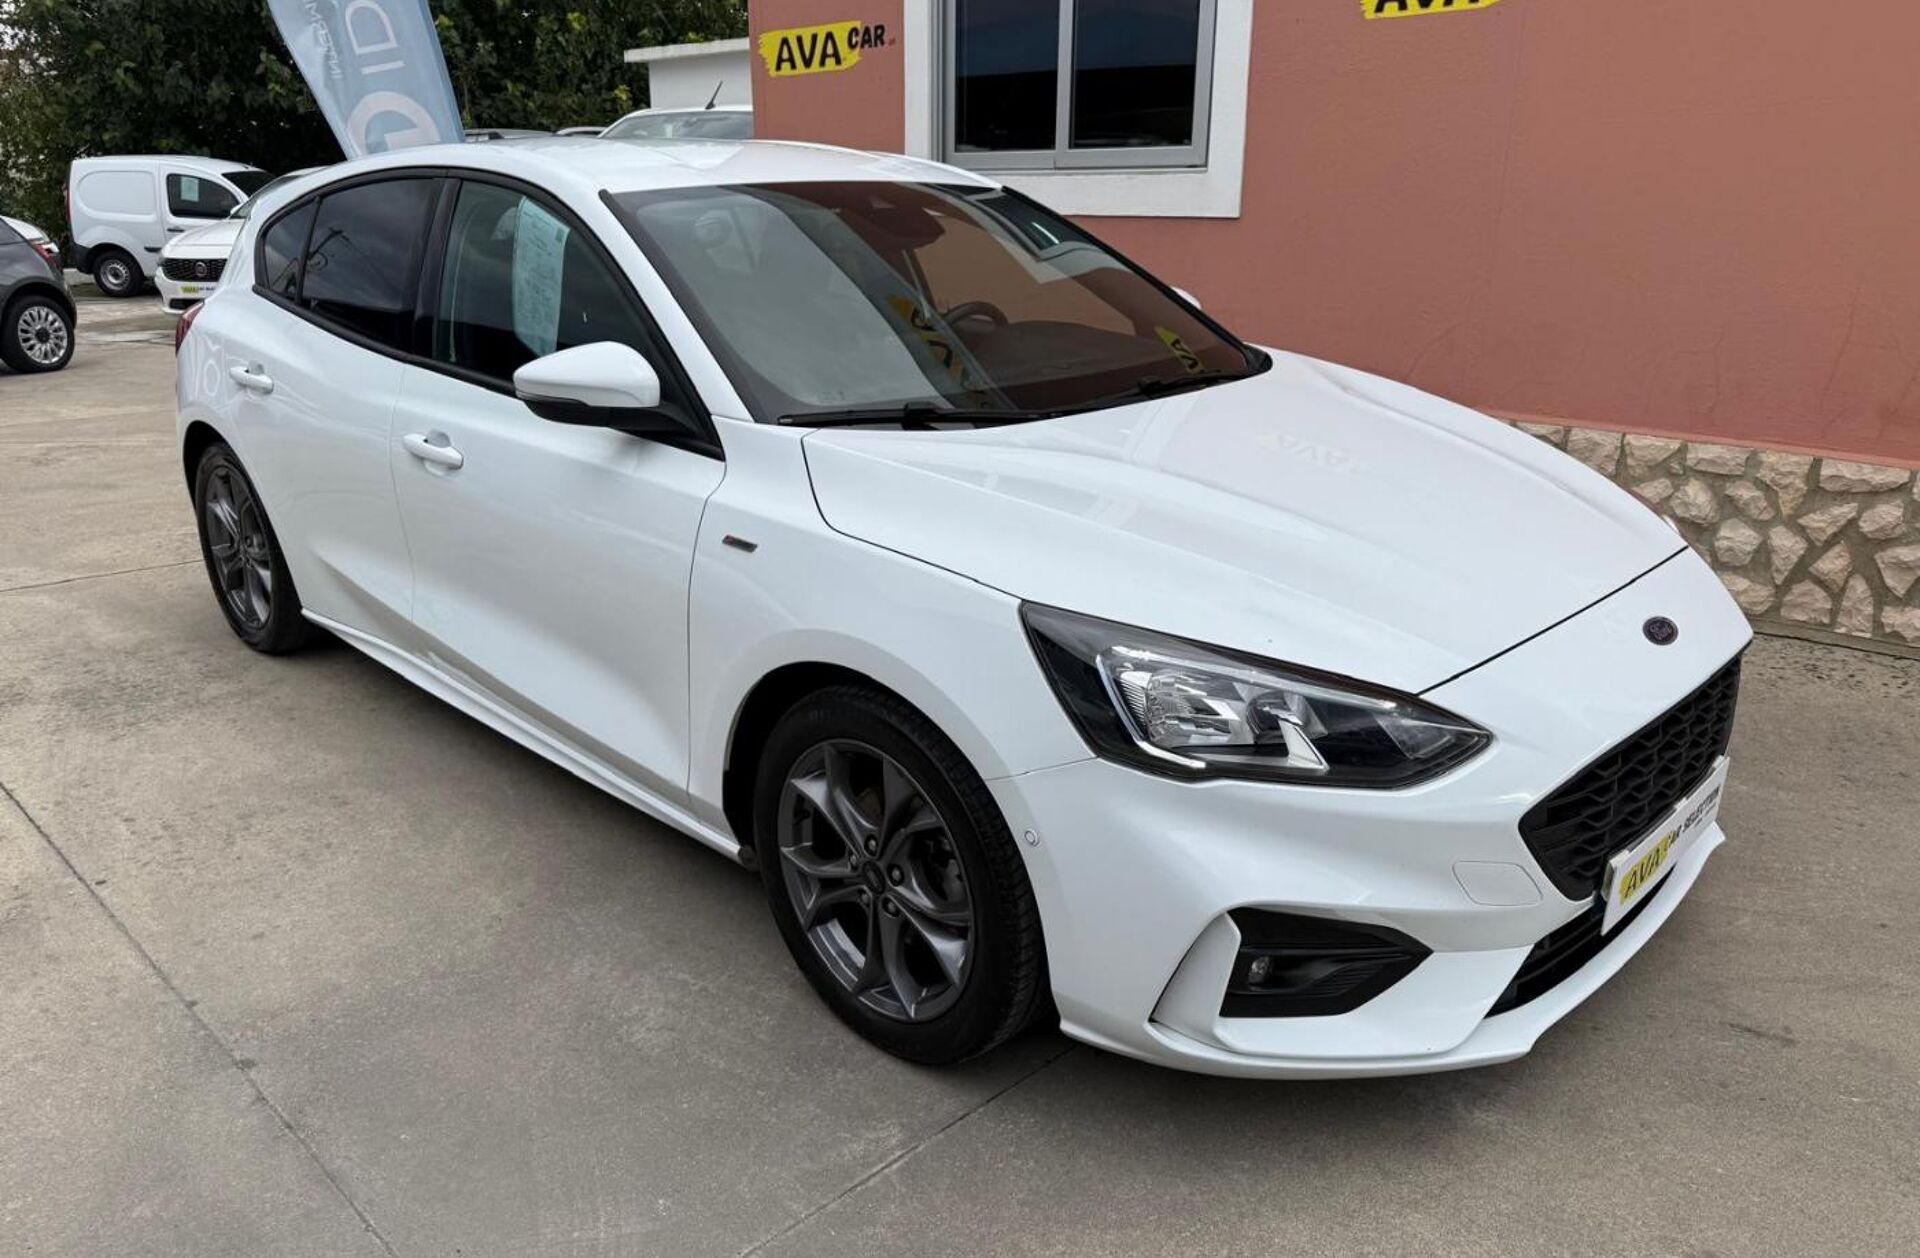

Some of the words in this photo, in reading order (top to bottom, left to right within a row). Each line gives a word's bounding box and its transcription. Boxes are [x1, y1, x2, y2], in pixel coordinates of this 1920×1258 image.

[775, 31, 842, 71] AVA
[847, 24, 886, 50] CAR
[1624, 846, 1660, 899] AVA
